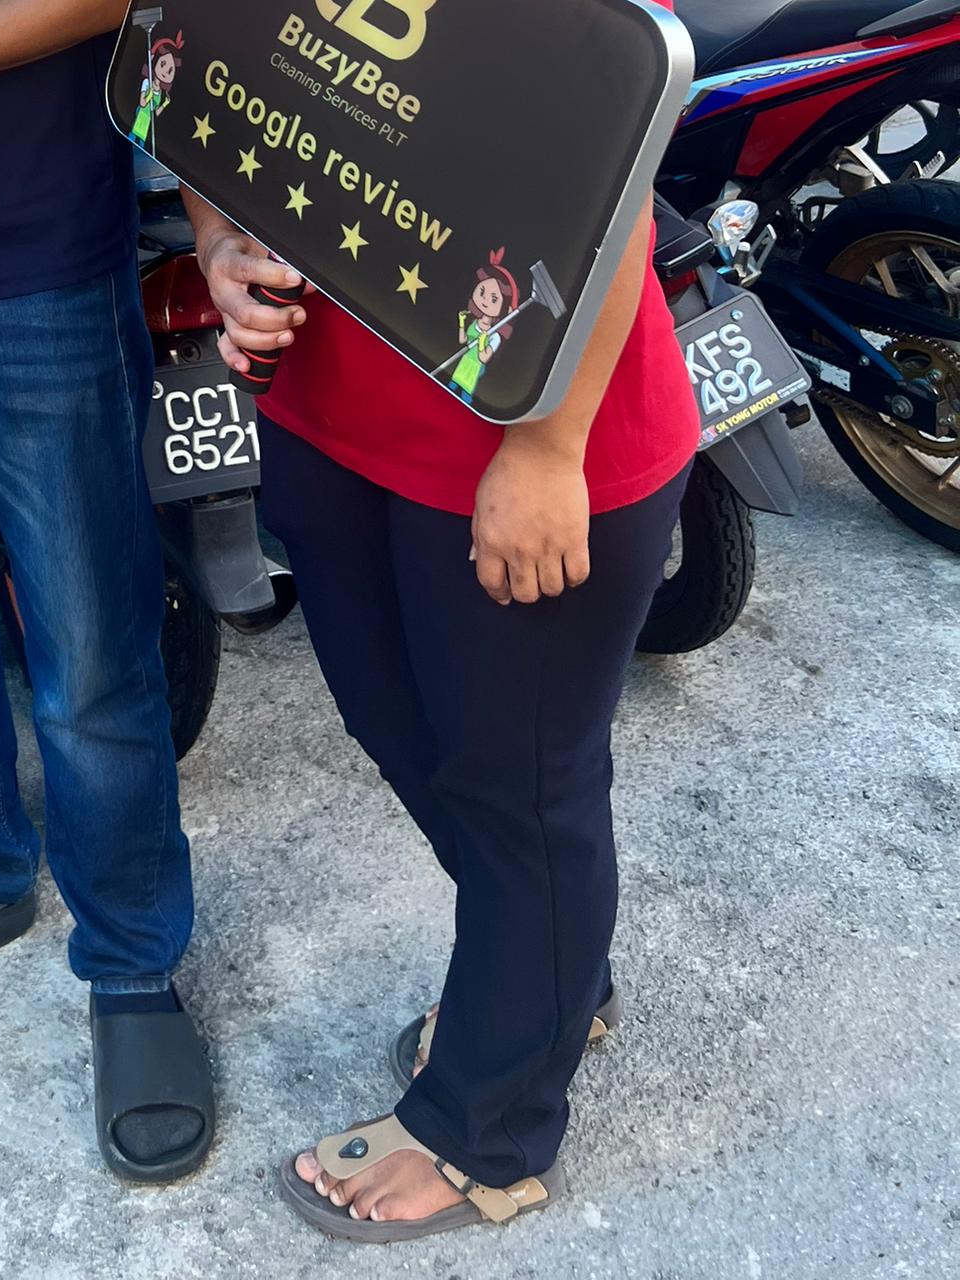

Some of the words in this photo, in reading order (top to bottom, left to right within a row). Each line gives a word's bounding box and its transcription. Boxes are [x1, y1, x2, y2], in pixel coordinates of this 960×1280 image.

[277, 13, 421, 123] BuzyBee
[270, 52, 322, 97] Cleaning
[322, 87, 378, 131] Services
[378, 123, 409, 148] PLT
[205, 60, 317, 161] Google
[323, 148, 453, 252] review
[685, 323, 752, 384] KFS
[164, 383, 241, 432] CCT
[701, 357, 773, 415] 492
[715, 421, 730, 433] SK
[725, 408, 751, 427] YONG
[749, 392, 780, 414] MOTOR
[164, 421, 261, 475] 6521
